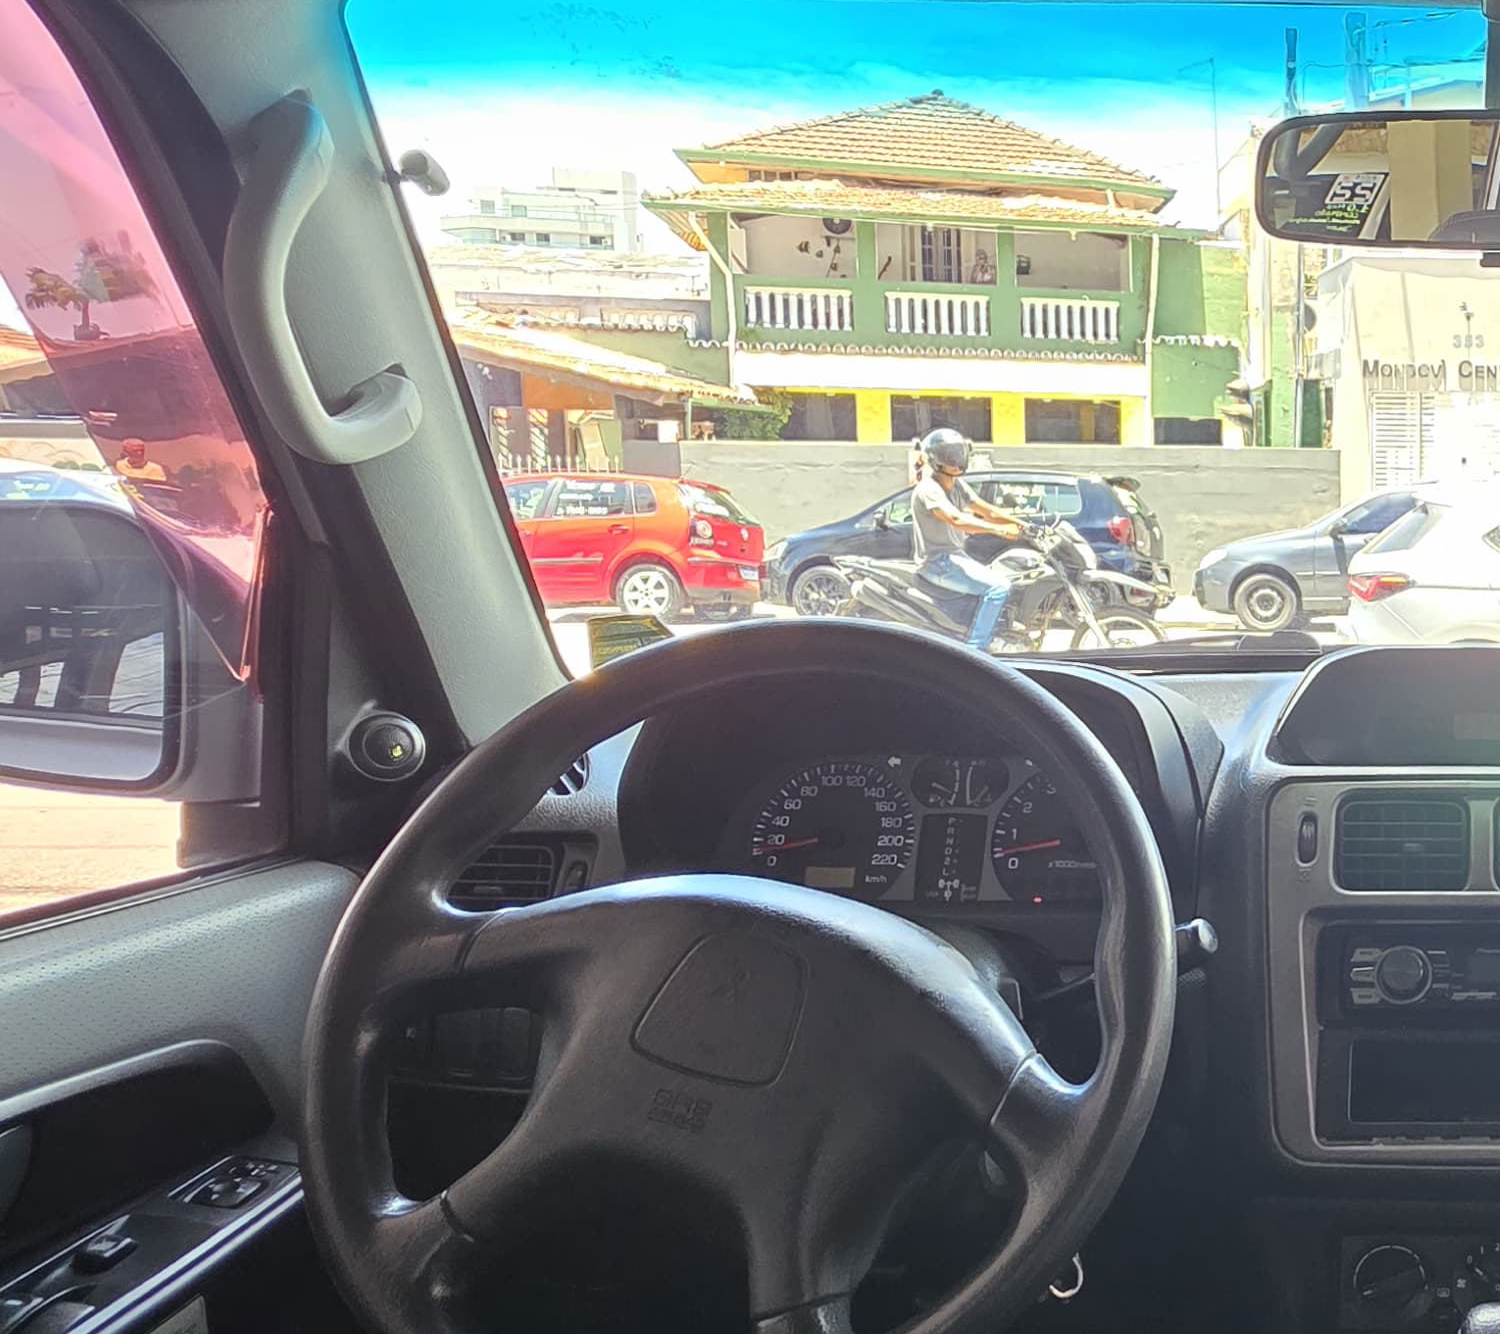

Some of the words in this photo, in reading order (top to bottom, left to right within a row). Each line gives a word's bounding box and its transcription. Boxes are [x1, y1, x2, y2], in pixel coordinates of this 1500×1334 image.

[821, 776, 842, 787] 100
[846, 776, 866, 787] 120
[800, 786, 818, 798] 80
[864, 787, 885, 799] 140
[784, 799, 802, 810] 60
[875, 800, 896, 812] 160
[1023, 801, 1033, 814] 2
[771, 815, 790, 827] 40
[881, 817, 902, 828] 180
[767, 834, 785, 845] 20
[1010, 827, 1017, 840] 1
[877, 835, 904, 847] 200
[767, 856, 777, 866] 0
[871, 854, 897, 866] 220
[1007, 857, 1018, 869] 0
[865, 873, 887, 885] km/h
